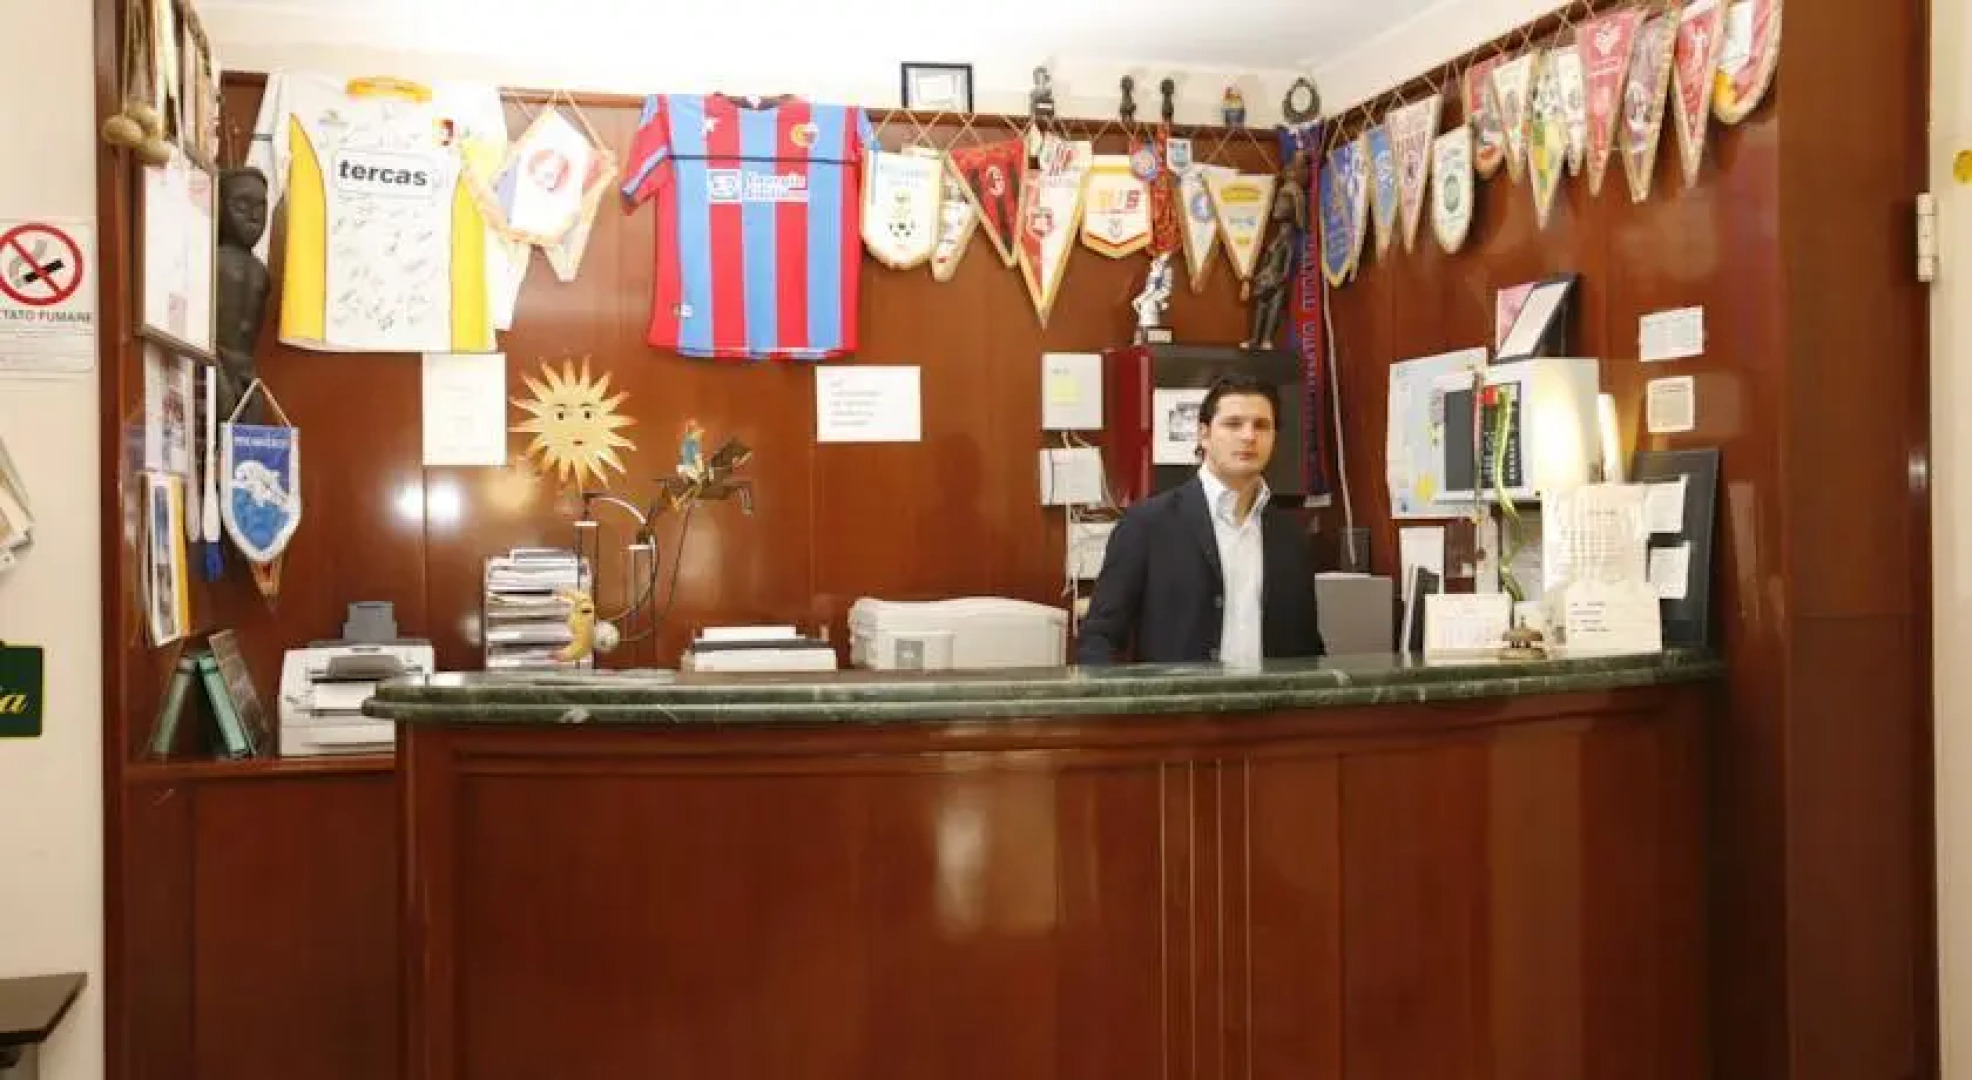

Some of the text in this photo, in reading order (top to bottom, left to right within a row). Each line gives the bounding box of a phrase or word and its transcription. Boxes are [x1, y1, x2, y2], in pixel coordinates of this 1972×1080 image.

[338, 159, 428, 187] tercas
[0, 308, 94, 323] TATO FUMARE
